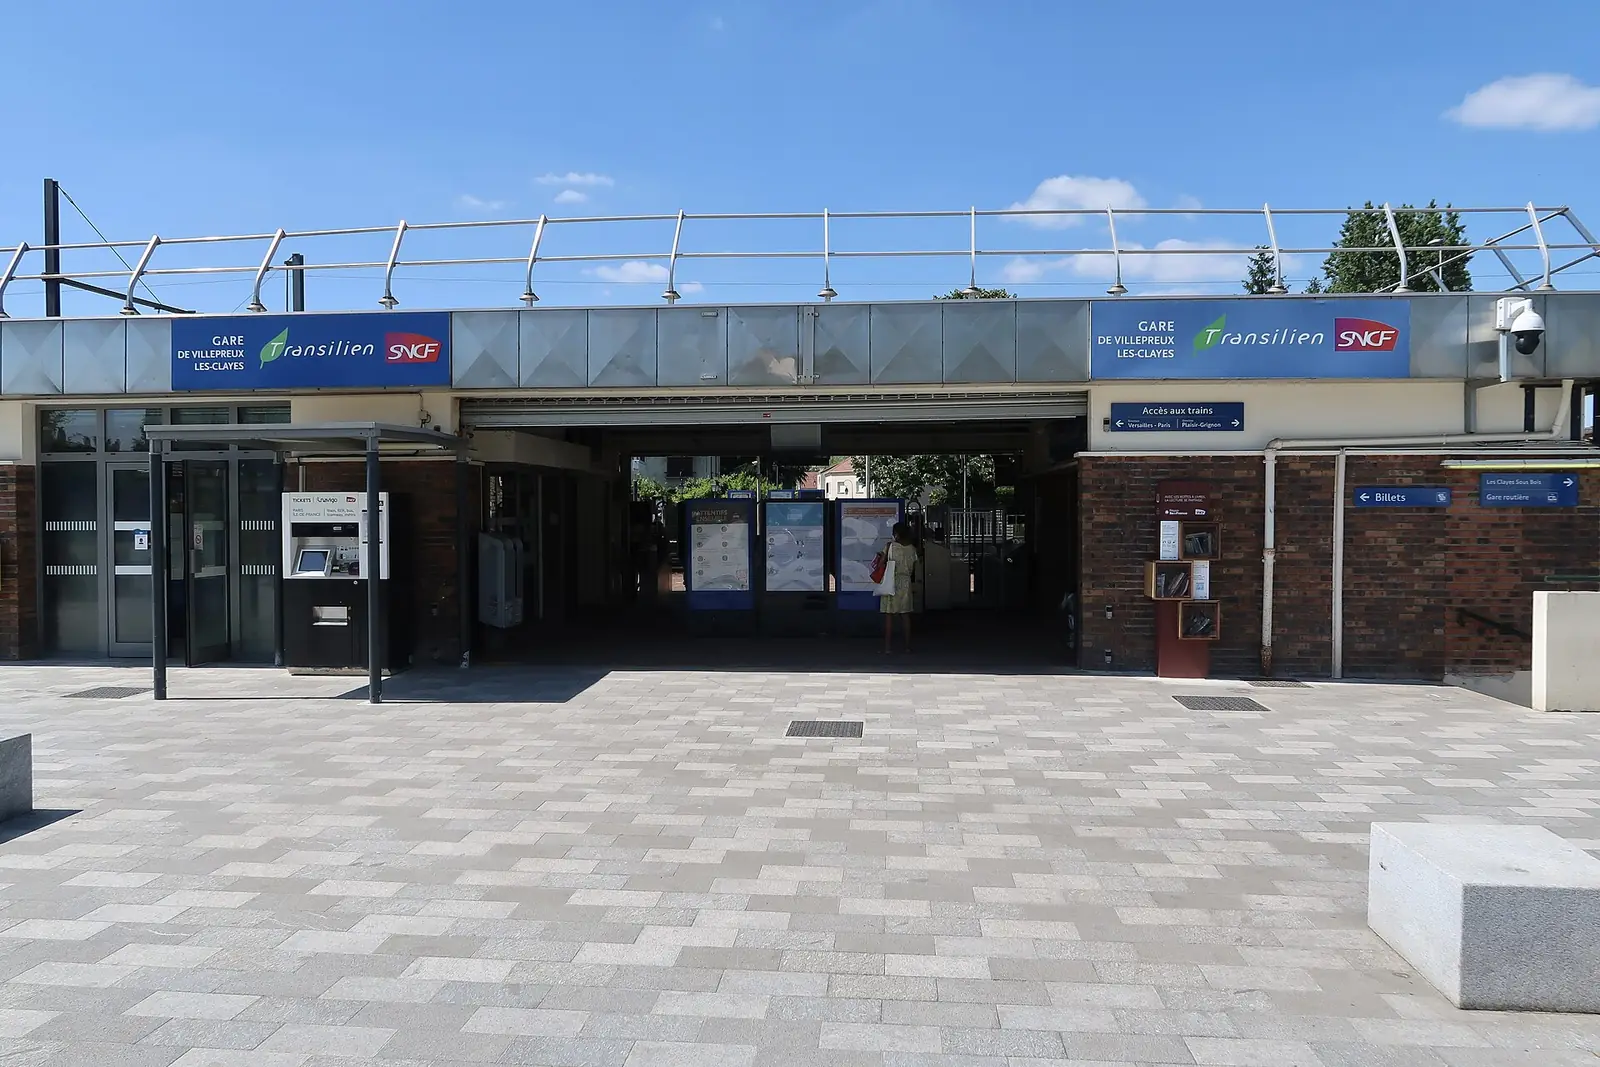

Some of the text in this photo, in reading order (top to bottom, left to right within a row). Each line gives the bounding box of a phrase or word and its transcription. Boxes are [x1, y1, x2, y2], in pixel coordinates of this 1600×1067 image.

[1138, 321, 1174, 332] GARE
[212, 336, 244, 346] GARE
[1098, 335, 1174, 345] DE VILLEPREUX
[1204, 328, 1324, 346] Transilien
[1337, 330, 1396, 348] SNCF
[270, 340, 374, 357] Transilien
[388, 343, 439, 360] SNCF
[1117, 349, 1174, 358] LES-CLAYES
[178, 349, 244, 359] DE VILLEPREUX
[194, 361, 244, 371] LES-CLAYES
[1142, 407, 1168, 415] Accès
[1188, 407, 1213, 415] trains
[1375, 493, 1406, 502] Billets
[1505, 493, 1530, 501] routière
